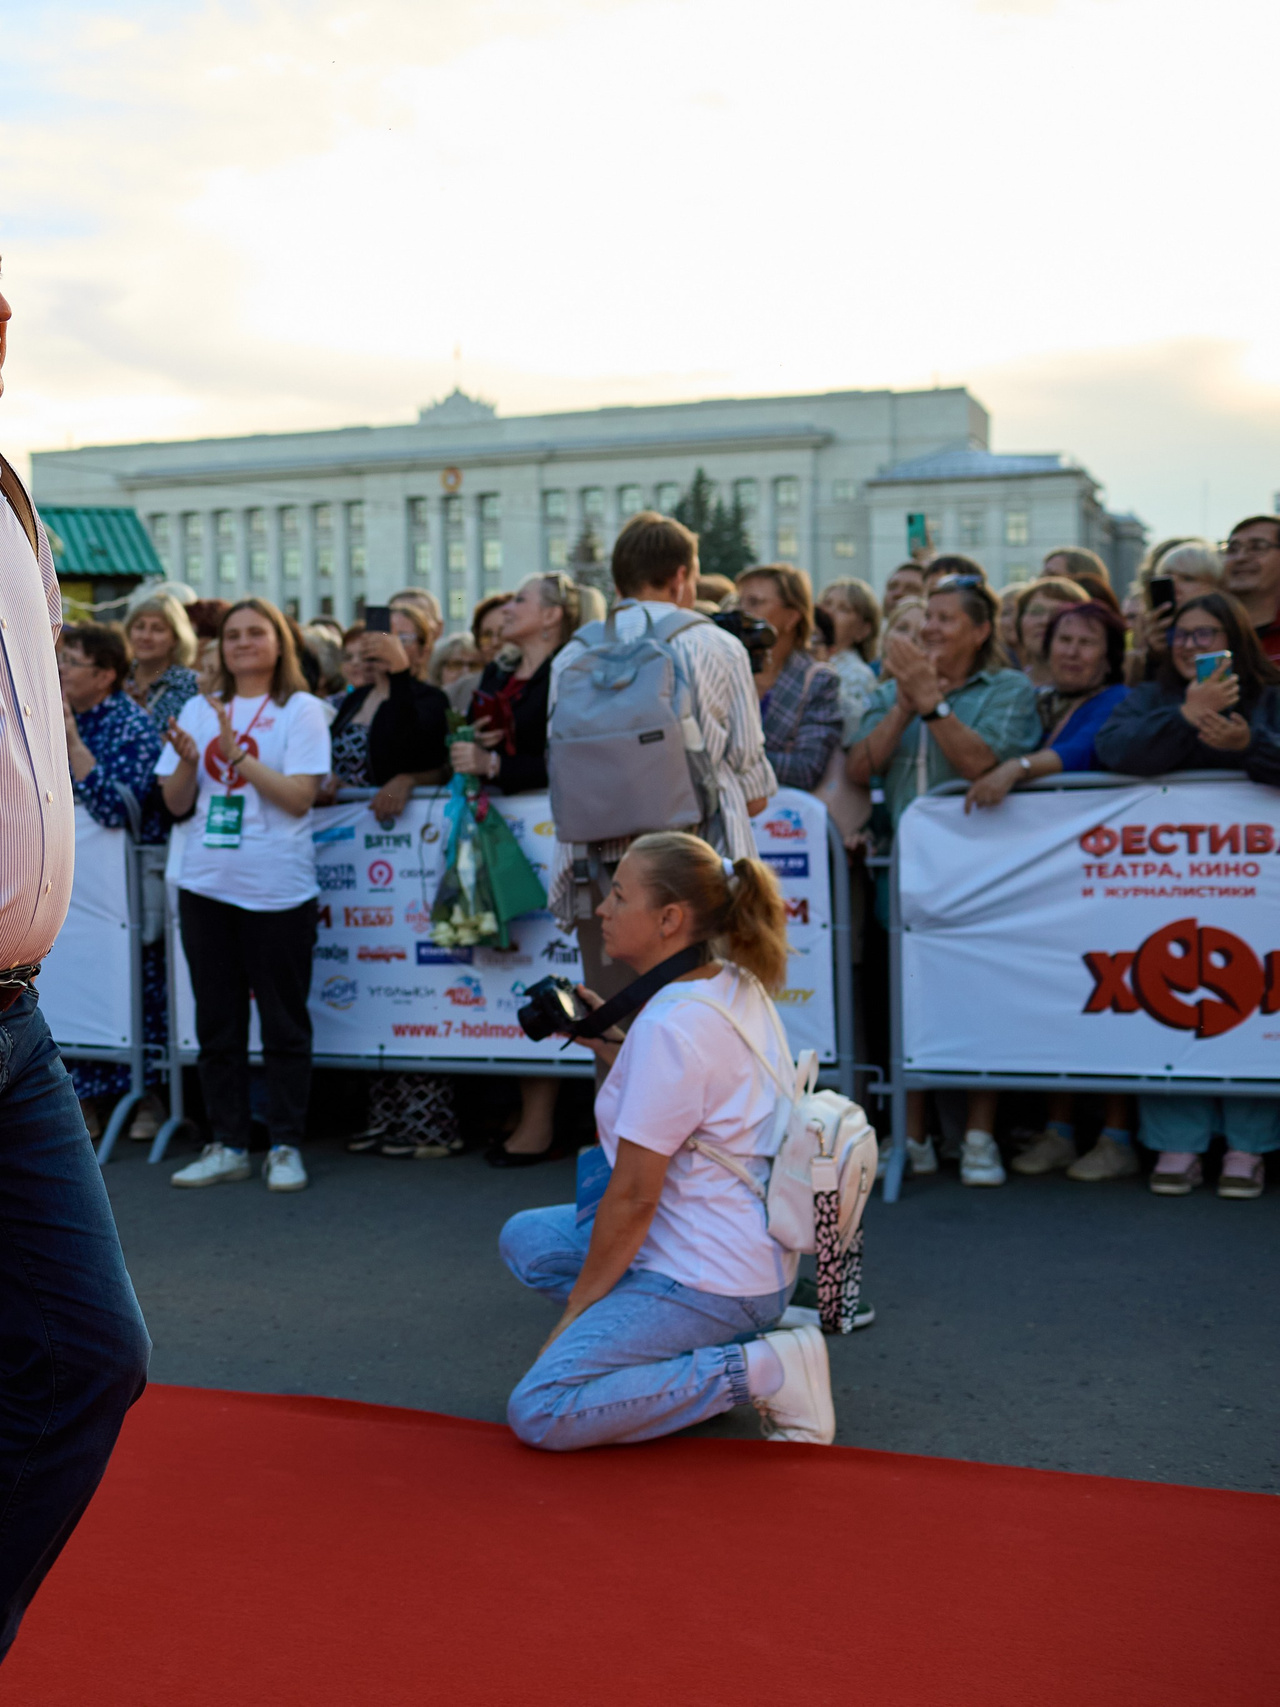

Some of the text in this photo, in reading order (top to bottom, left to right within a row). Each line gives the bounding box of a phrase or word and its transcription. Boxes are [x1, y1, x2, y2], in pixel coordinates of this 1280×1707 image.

[363, 832, 412, 850] ВЯТИЧ
[1080, 822, 1280, 857] ФЕСТИВ
[1081, 861, 1262, 882] ТЕАТРА, КИНО
[1081, 884, 1257, 899] И ЖУРНАЛИСТИКИ
[391, 1020, 526, 1040] www.7-holmov
